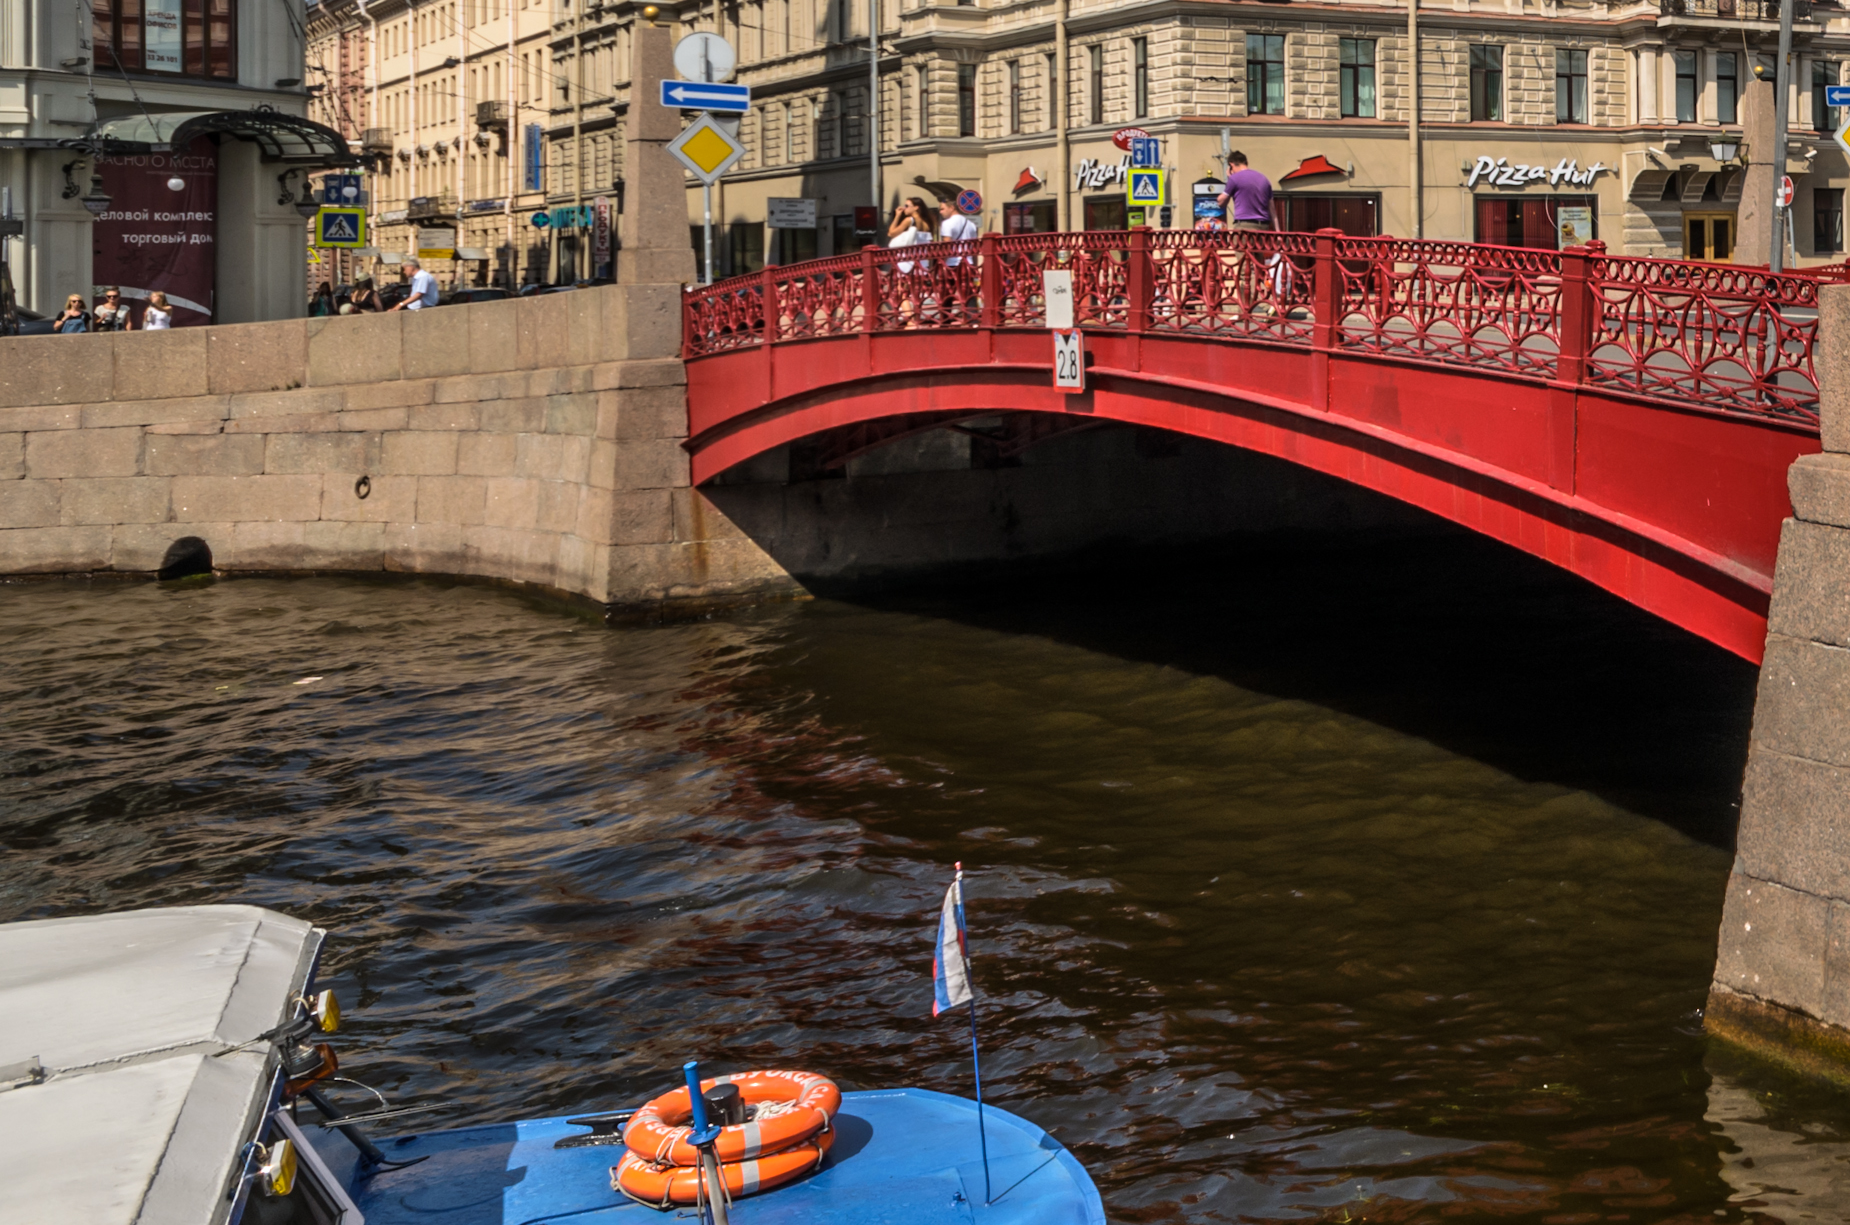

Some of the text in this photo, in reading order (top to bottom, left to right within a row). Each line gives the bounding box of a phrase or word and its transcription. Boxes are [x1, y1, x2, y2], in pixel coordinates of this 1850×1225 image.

[1076, 158, 1115, 190] Pizza
[1467, 156, 1609, 187] Pizza Hut
[549, 205, 592, 228] АПТЕКА
[597, 204, 609, 252] ПРОДУКТЫ
[122, 231, 186, 248] торговый
[1058, 350, 1078, 380] 2.8
